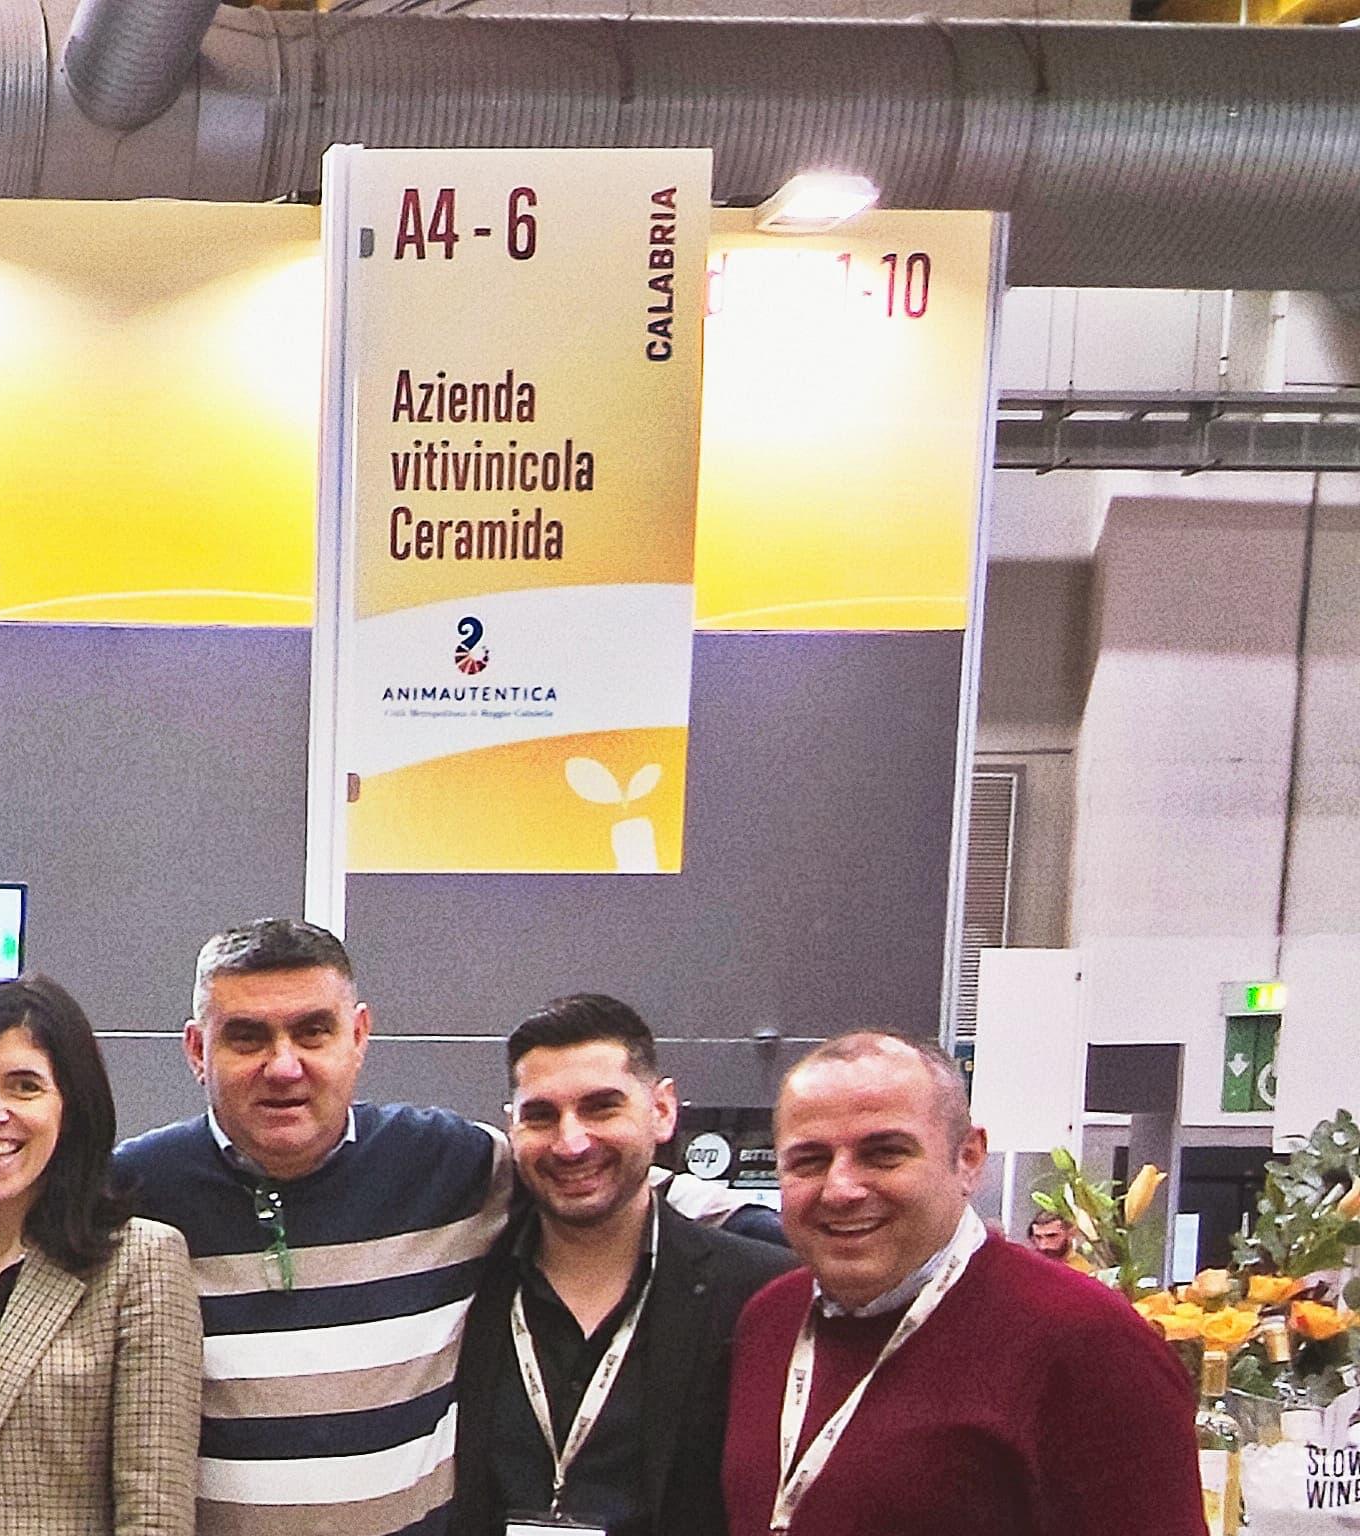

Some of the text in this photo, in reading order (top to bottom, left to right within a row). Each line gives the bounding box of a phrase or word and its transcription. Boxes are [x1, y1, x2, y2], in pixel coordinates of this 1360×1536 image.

[394, 187, 538, 261] A4 - 6
[645, 187, 678, 362] CALABRIA
[392, 369, 536, 424] Azienda
[390, 438, 595, 492] vitivinicola
[390, 506, 564, 561] Ceramida
[382, 686, 558, 702] ANIMAUTENTICA
[1306, 1479, 1360, 1509] WINE
